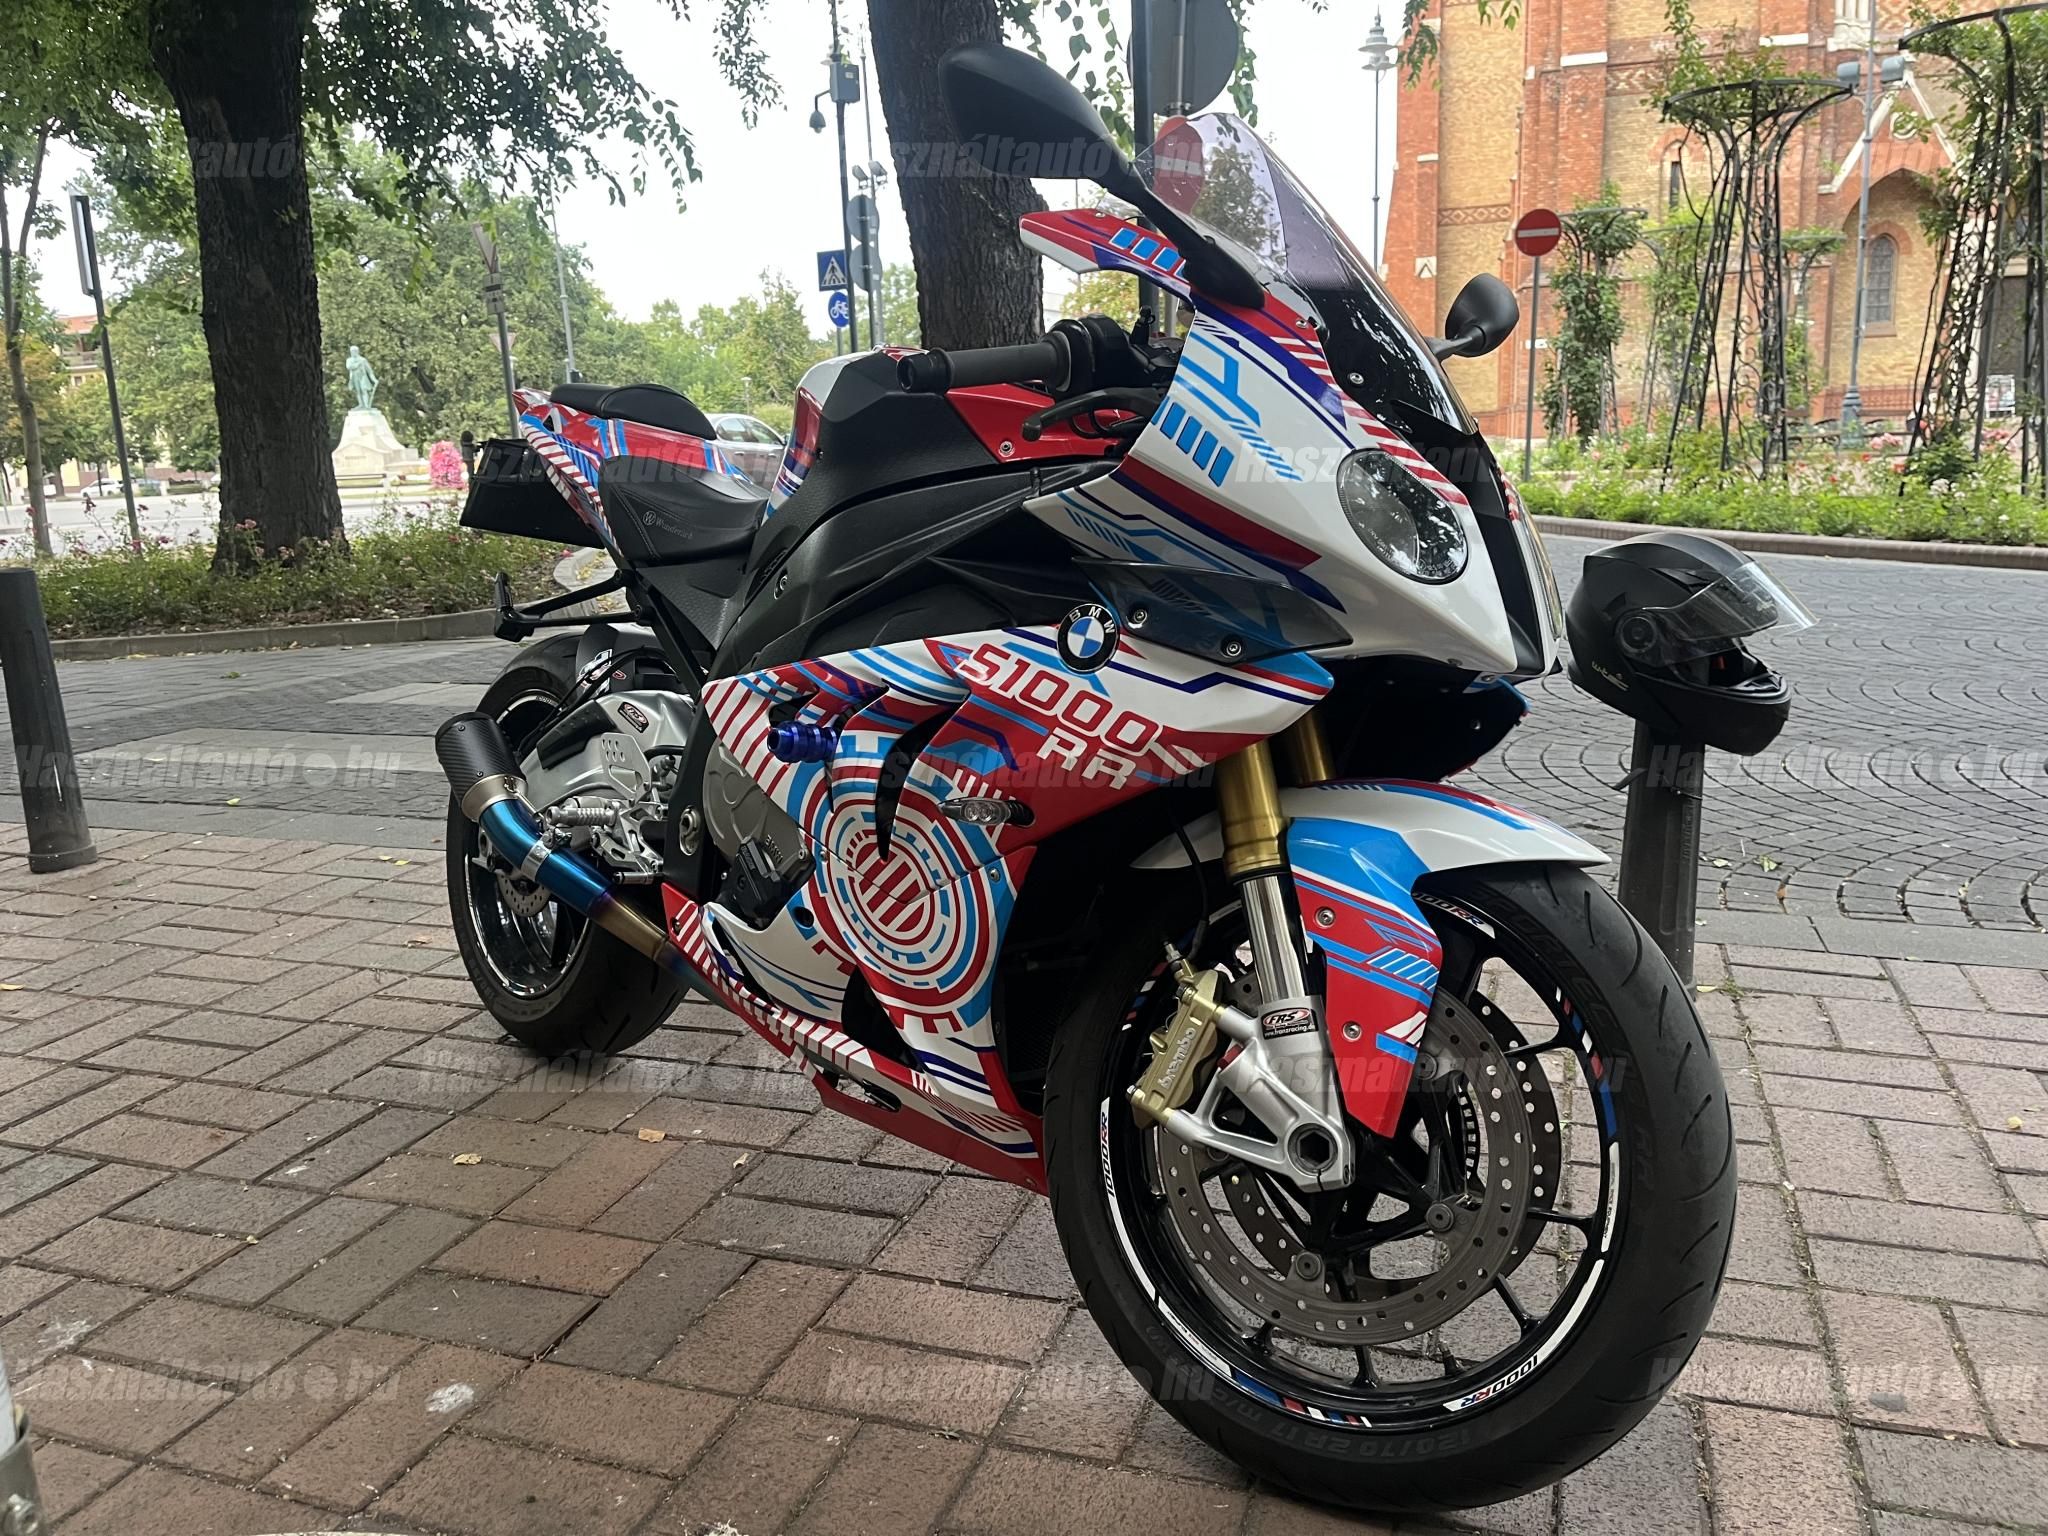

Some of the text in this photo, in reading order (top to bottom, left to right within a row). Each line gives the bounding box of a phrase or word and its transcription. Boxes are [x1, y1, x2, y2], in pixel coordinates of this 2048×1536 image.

[1069, 606, 1115, 633] BMW
[954, 642, 1162, 756] S1000
[1157, 1026, 1197, 1090] brembo
[1101, 1112, 1116, 1198] 1000RR
[1460, 1354, 1538, 1408] 1000RR
